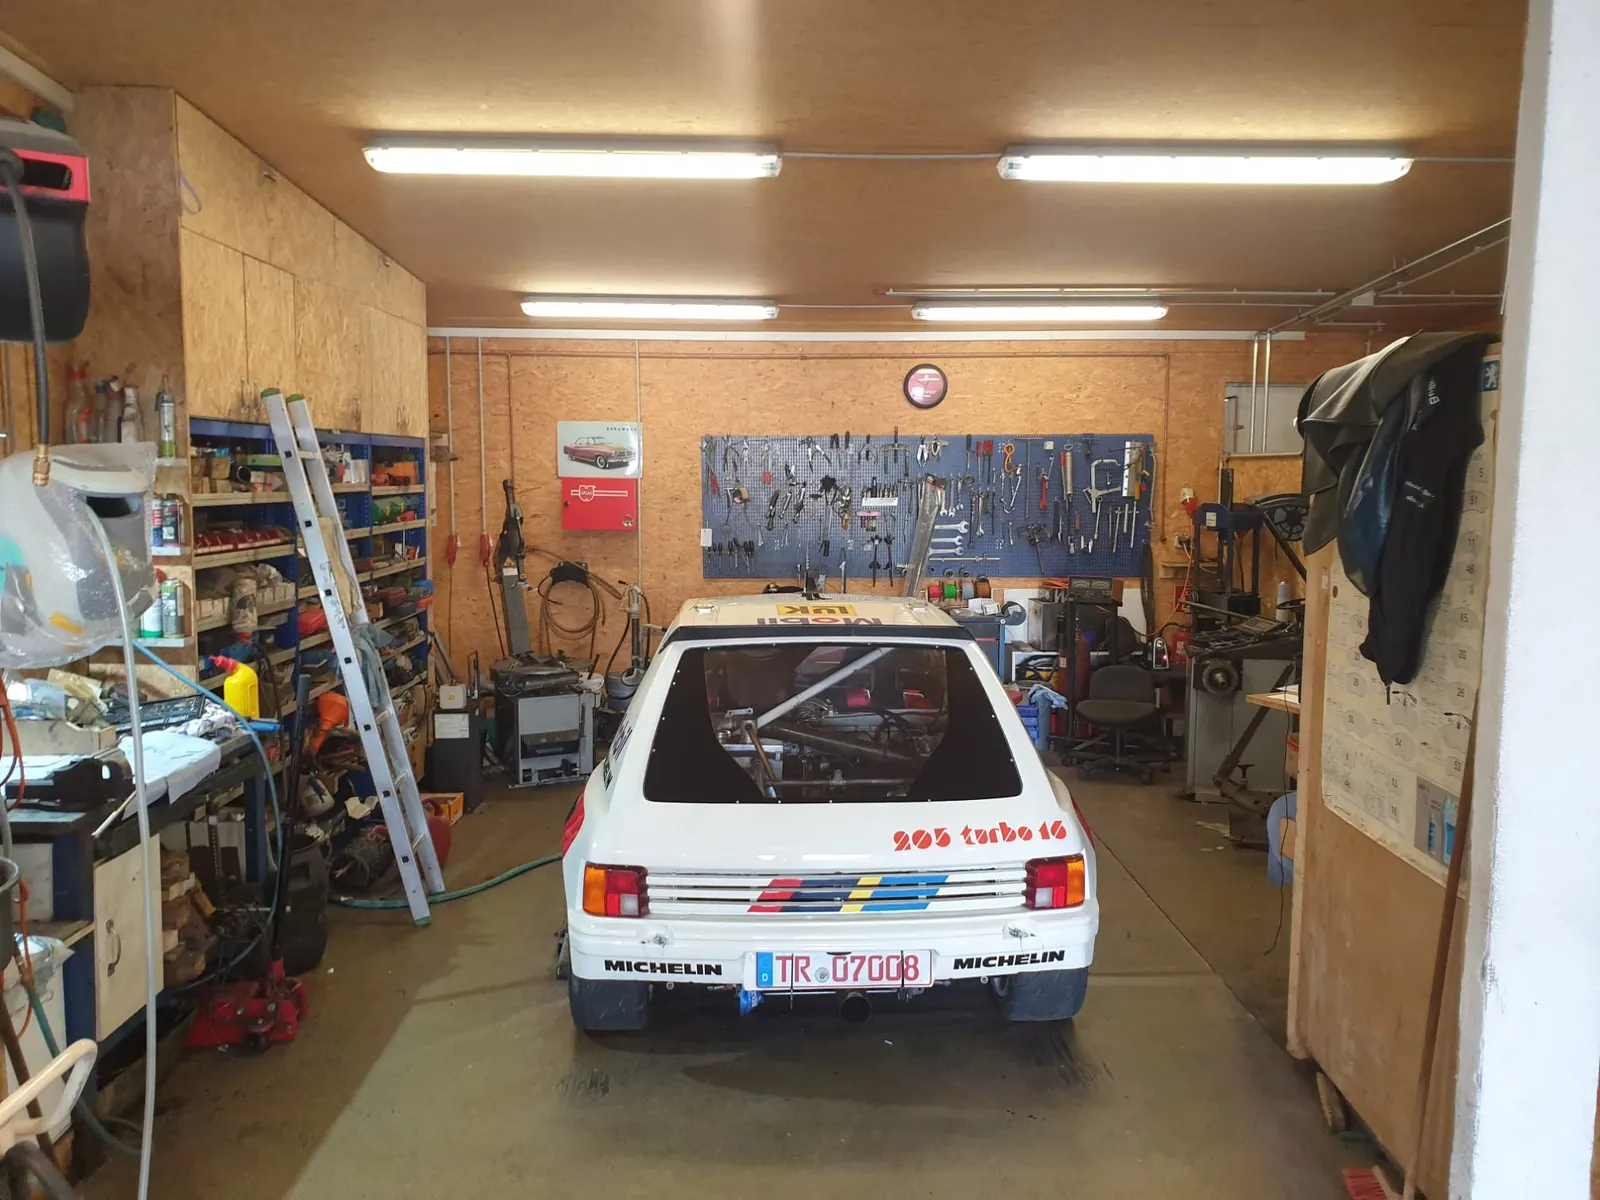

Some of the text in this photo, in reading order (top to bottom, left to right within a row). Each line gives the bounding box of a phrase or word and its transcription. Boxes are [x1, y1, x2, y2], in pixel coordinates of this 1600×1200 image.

[893, 820, 1067, 852] 205 turbo 16
[604, 959, 723, 976] MICHELIN
[775, 954, 920, 983] TR 07008
[953, 949, 1065, 970] MICHELIN
[762, 972, 769, 982] D
